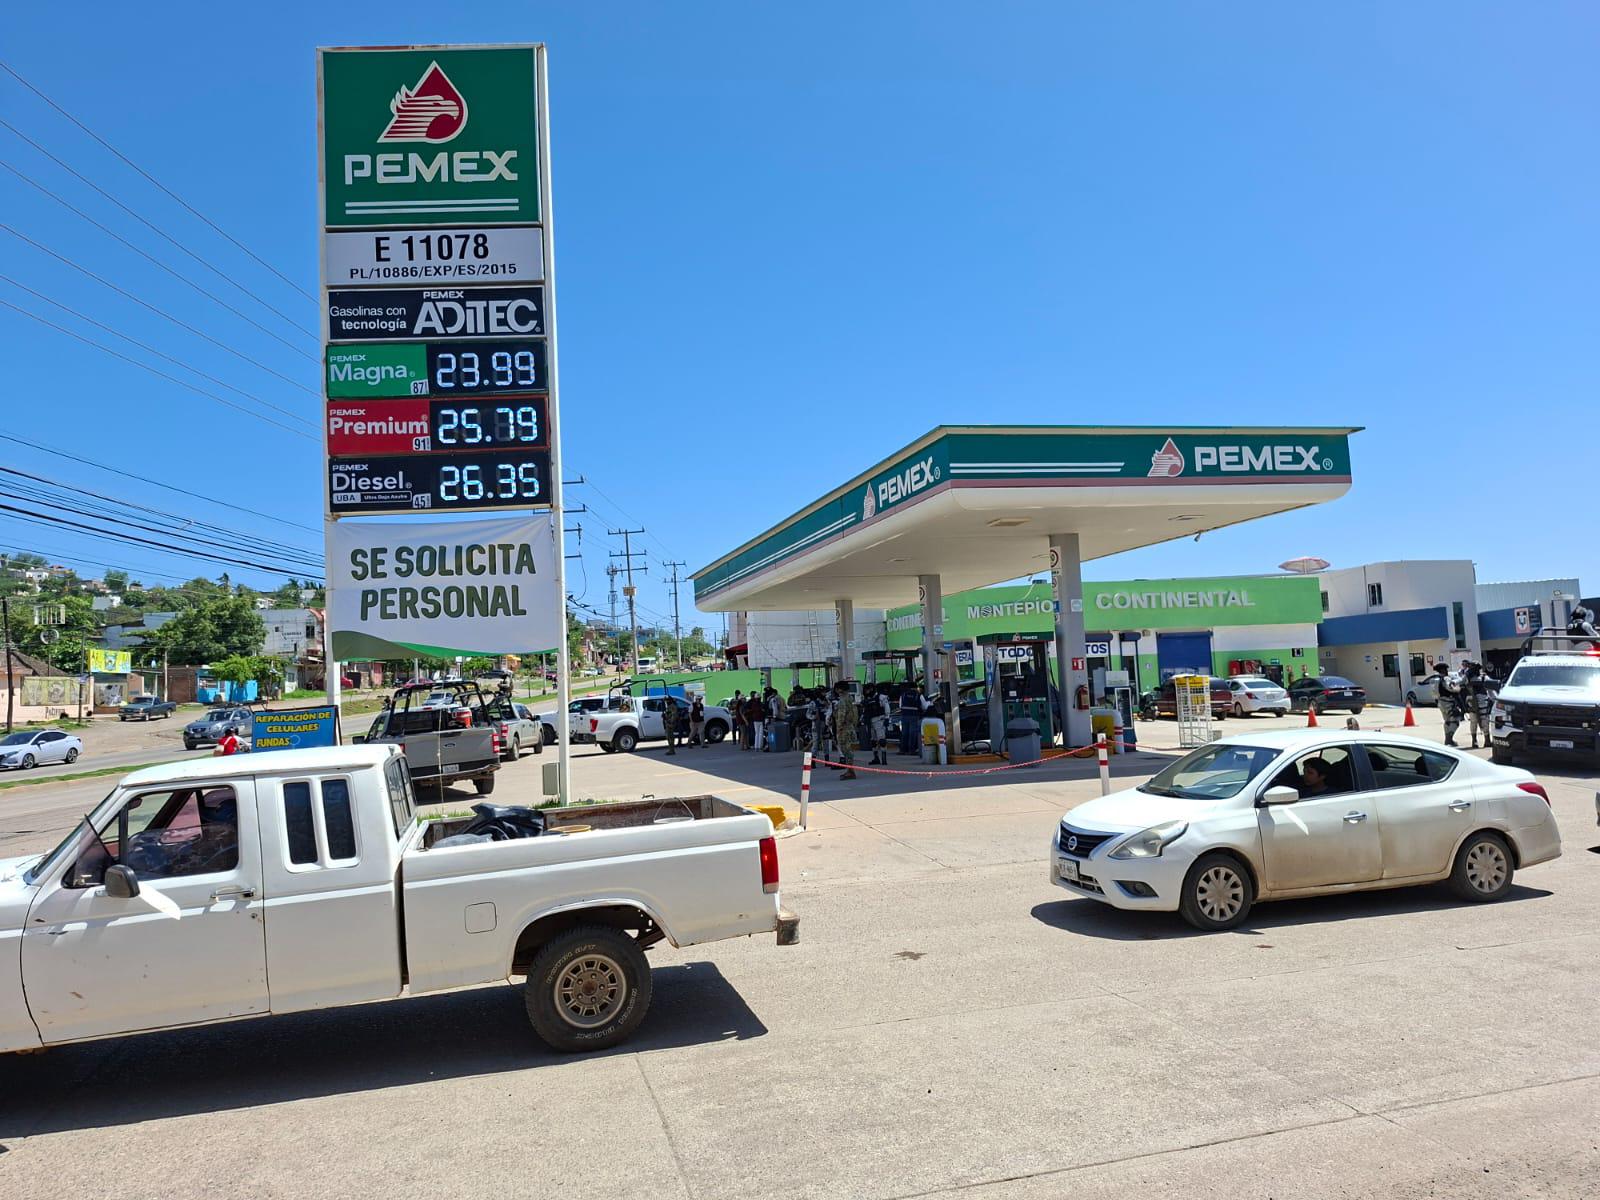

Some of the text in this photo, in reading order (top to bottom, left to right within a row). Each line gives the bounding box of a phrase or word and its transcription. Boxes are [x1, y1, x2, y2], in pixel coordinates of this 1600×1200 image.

[344, 150, 518, 185] PEMEX
[375, 233, 489, 262] E 11078
[350, 263, 517, 279] PL/10886/EXP/ES/2015
[423, 291, 464, 299] PEMEX
[329, 306, 407, 317] Gasolinas con
[342, 318, 407, 331] tecnología
[330, 354, 366, 362] PEMEX
[330, 363, 407, 385] Magna
[436, 351, 535, 388] 23.99
[413, 382, 424, 394] 87
[329, 416, 428, 435] Premium
[438, 406, 538, 444] 25.79
[414, 439, 426, 450] 91
[1194, 445, 1321, 472] PEMEX
[332, 471, 403, 491] Diesel
[439, 463, 540, 501] 26.35
[878, 456, 934, 508] PEMEX
[350, 543, 536, 581] SE SOLICITA
[360, 584, 527, 621] PERSONAL
[1095, 589, 1256, 609] CONTINENTAL
[256, 712, 316, 723] REPARACIÓN
[266, 723, 319, 733] CELULARES
[256, 737, 290, 747] FUNDAS
